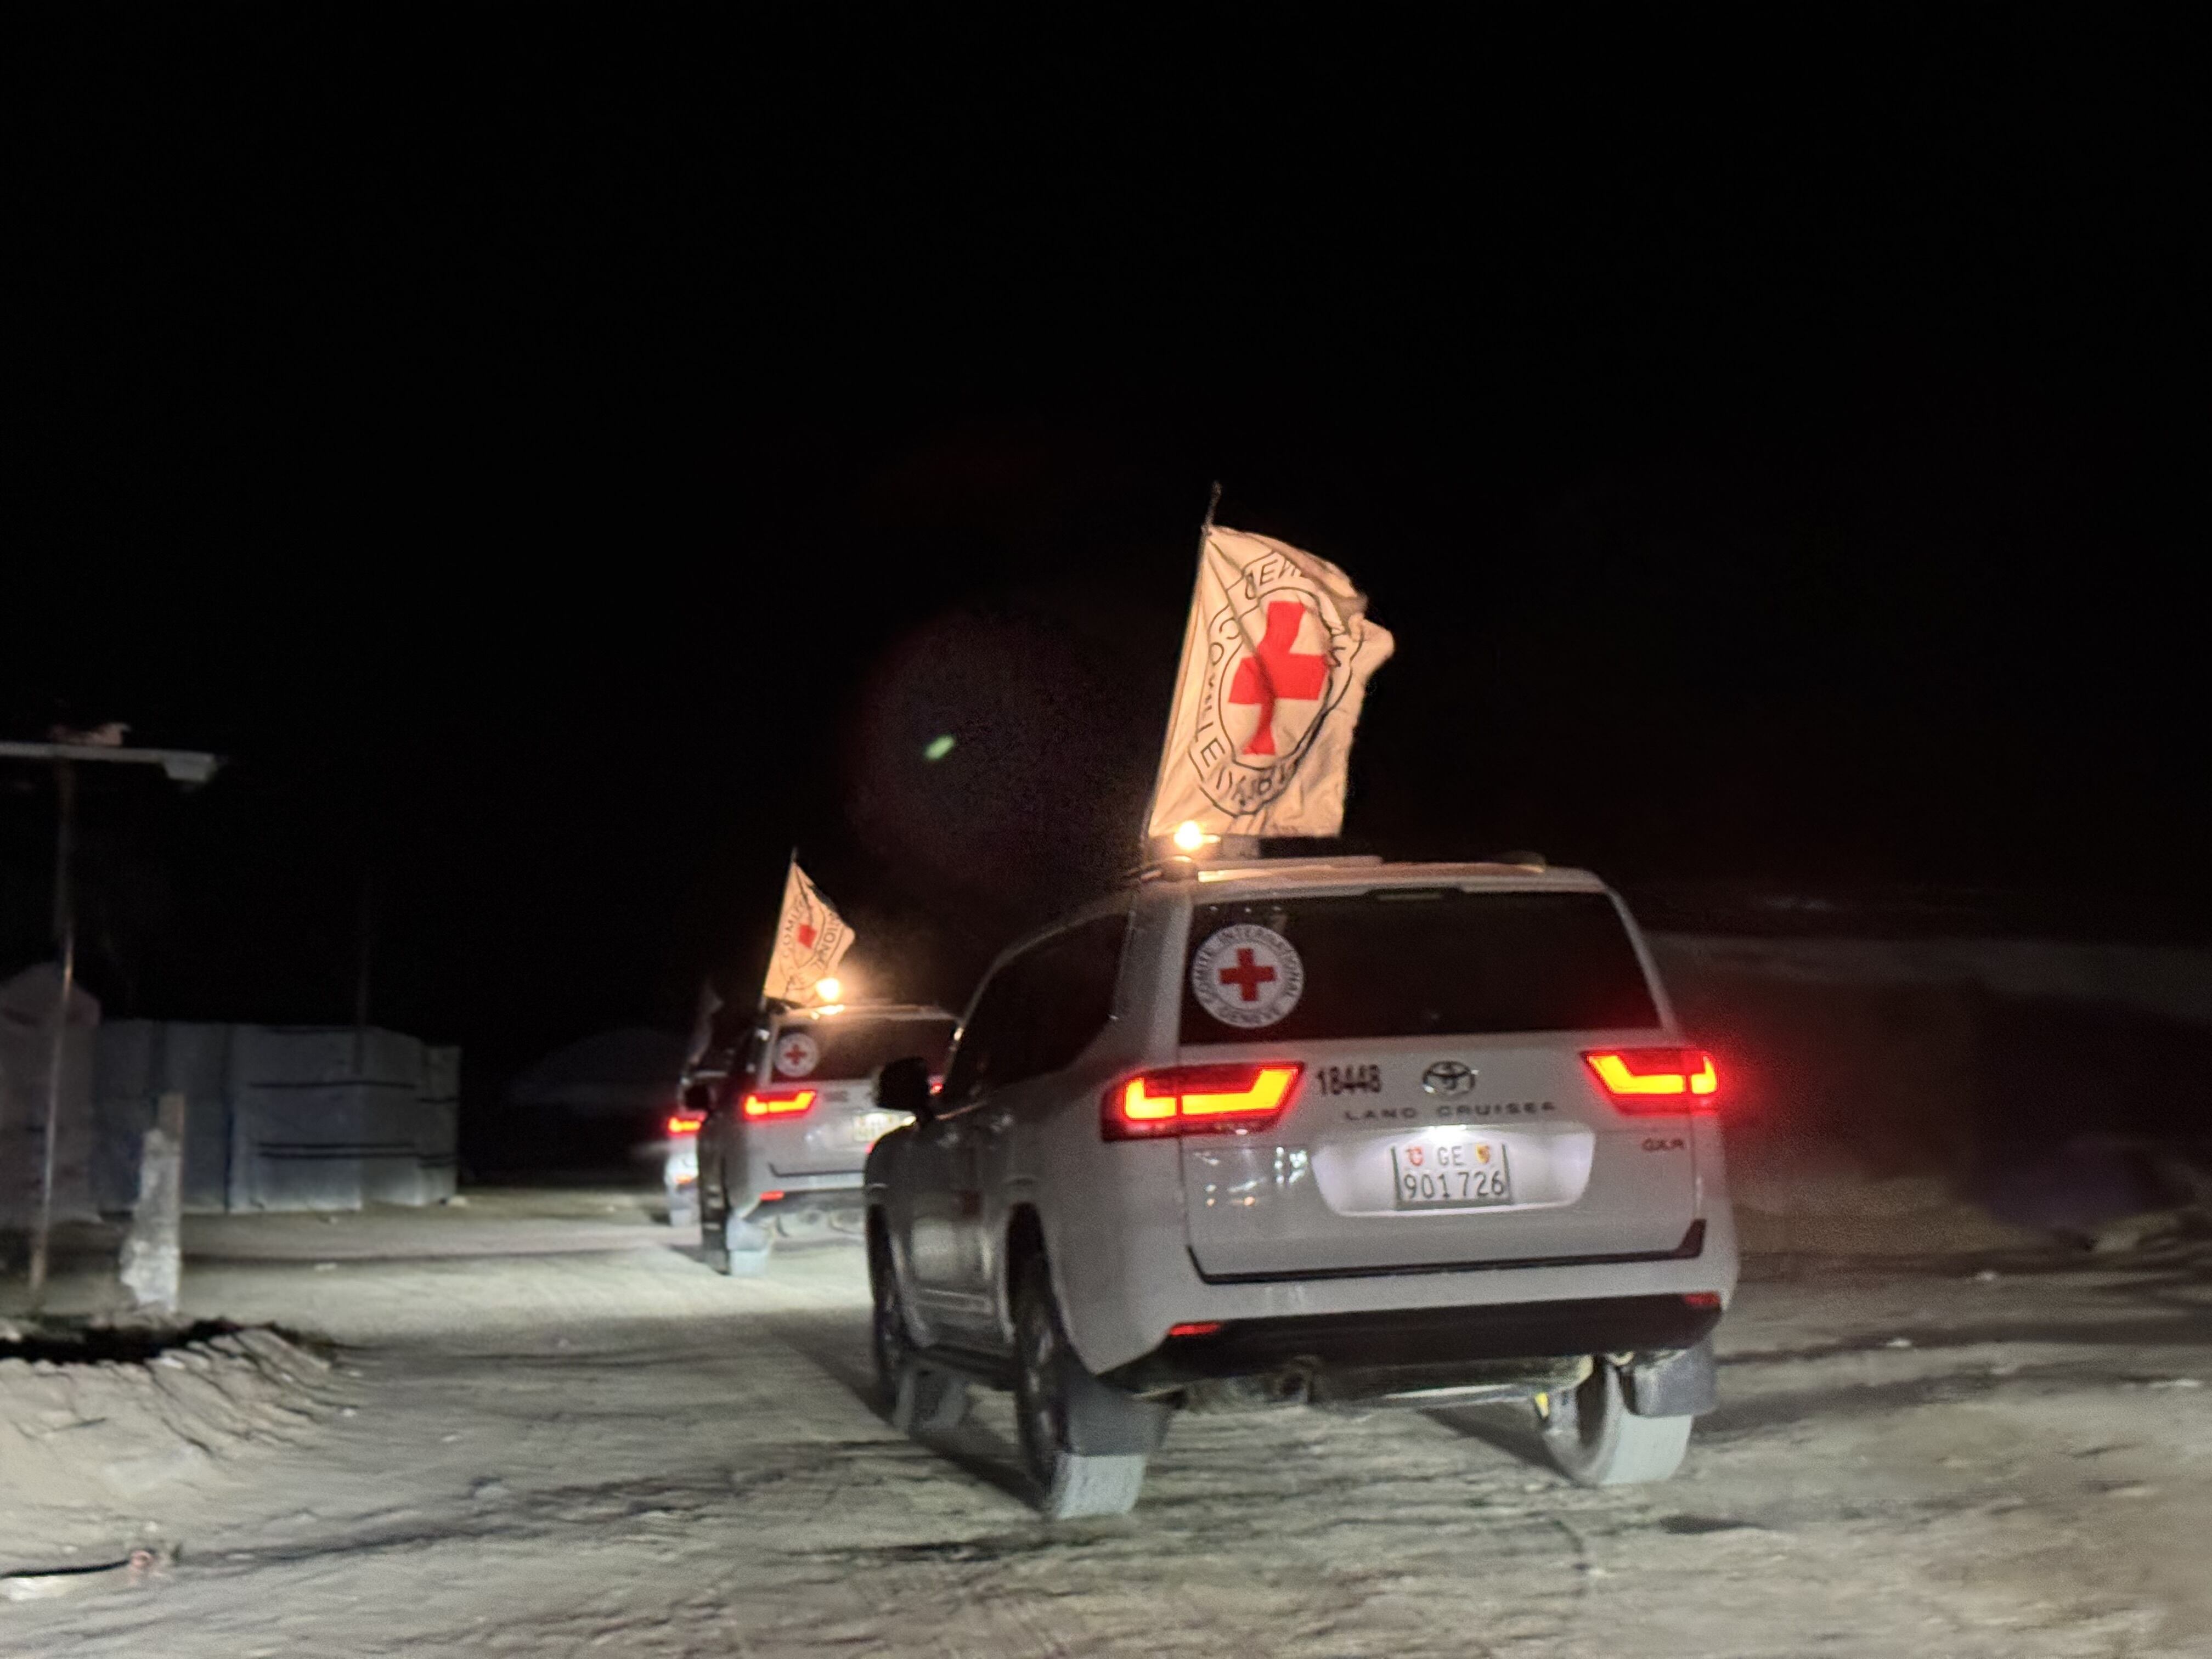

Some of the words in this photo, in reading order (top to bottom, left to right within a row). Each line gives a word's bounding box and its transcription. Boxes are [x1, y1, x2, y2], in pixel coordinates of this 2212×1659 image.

[1344, 1107, 1418, 1120] LAND
[1436, 1101, 1556, 1117] CRUISER
[1437, 1145, 1465, 1166] GE
[1404, 1170, 1505, 1199] 901726
